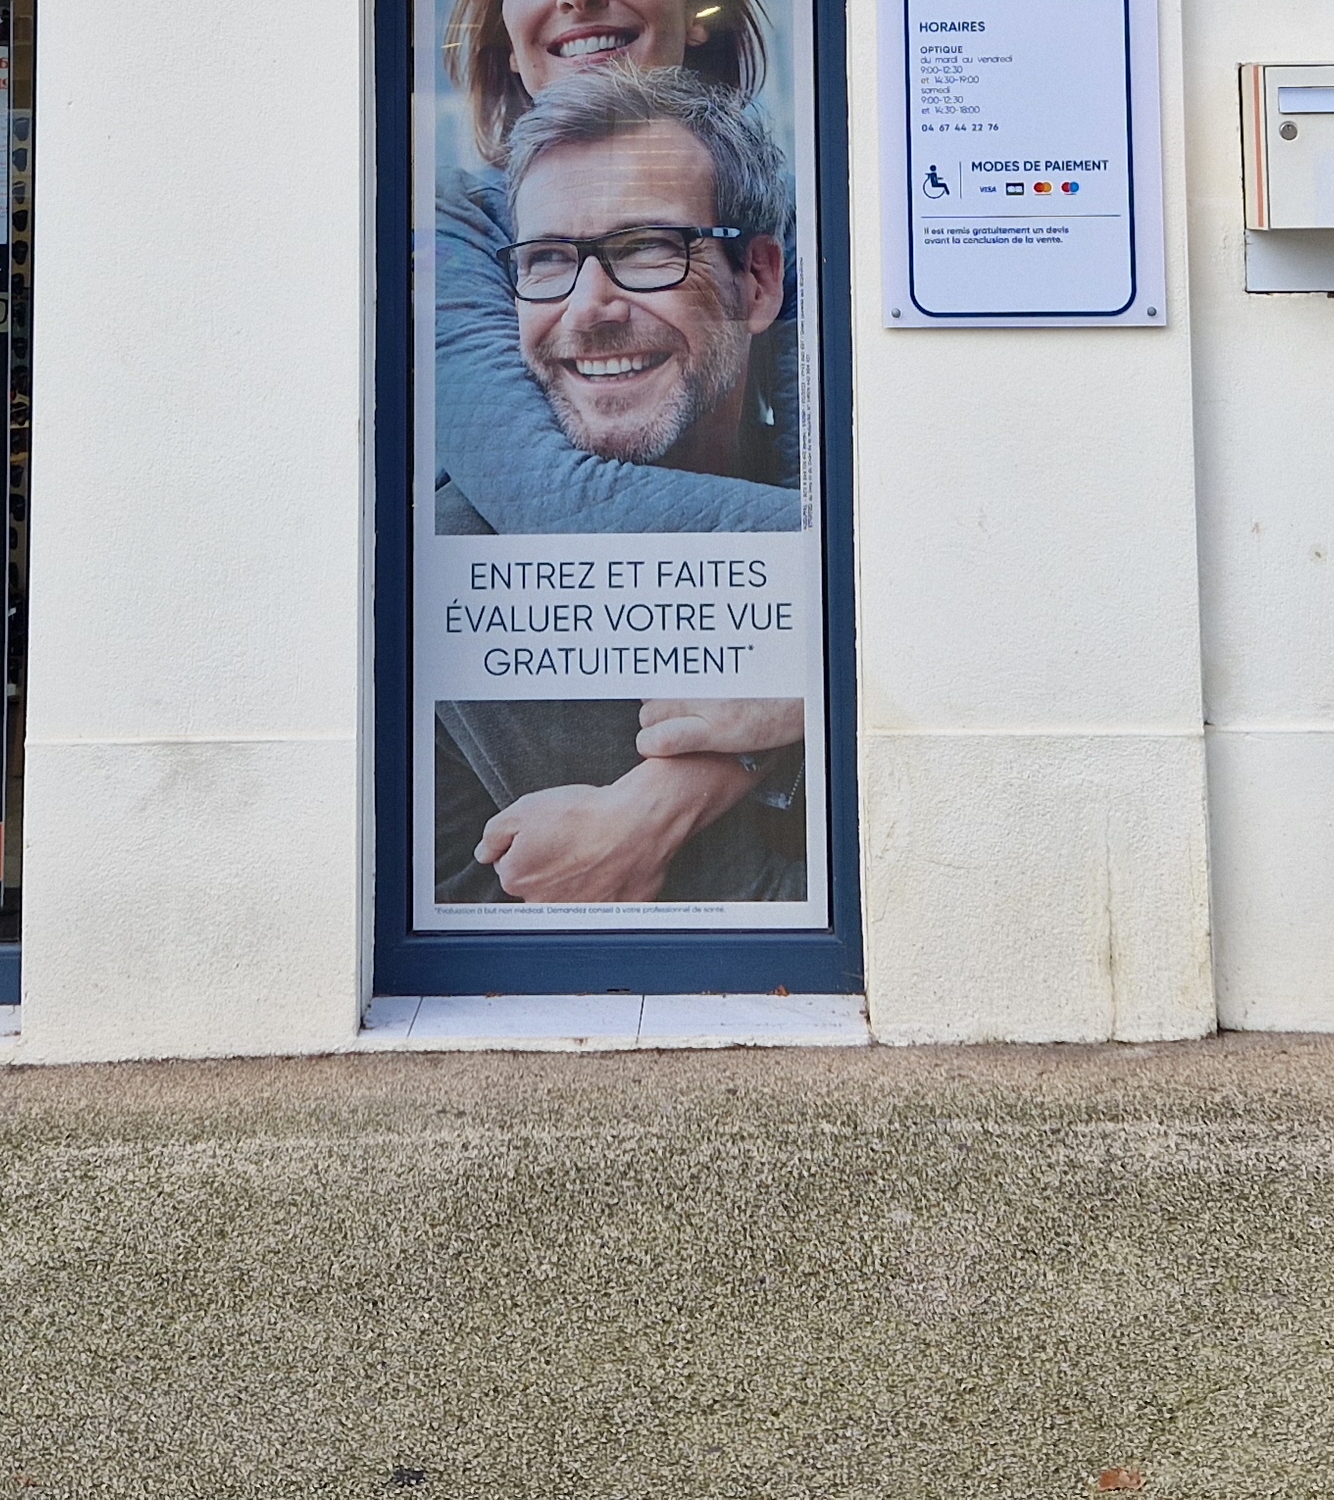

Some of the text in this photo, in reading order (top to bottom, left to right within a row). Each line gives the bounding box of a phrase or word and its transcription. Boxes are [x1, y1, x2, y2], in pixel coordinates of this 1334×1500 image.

[919, 21, 986, 33] HORAIRES
[920, 45, 964, 55] OPTIQUE
[920, 56, 932, 64] du
[962, 56, 973, 64] au
[977, 55, 1013, 64] vendredi
[921, 86, 951, 94] samedi
[921, 123, 999, 132] 04 67 44 22 76
[971, 159, 1109, 173] MODES DE PAIEMENT
[931, 227, 945, 235] est
[946, 227, 971, 235] remis
[972, 226, 1031, 236] gratuitement
[1032, 227, 1045, 235] un
[1046, 225, 1070, 234] devis
[923, 235, 1064, 245] avant la conclusion de la vente.
[470, 559, 768, 591] ENTREZ ET FAITES
[445, 598, 794, 634] ÉVALUER VOTRE VUE
[546, 906, 587, 914] Demandez
[588, 906, 614, 914] conseil
[642, 906, 691, 915] professionnel
